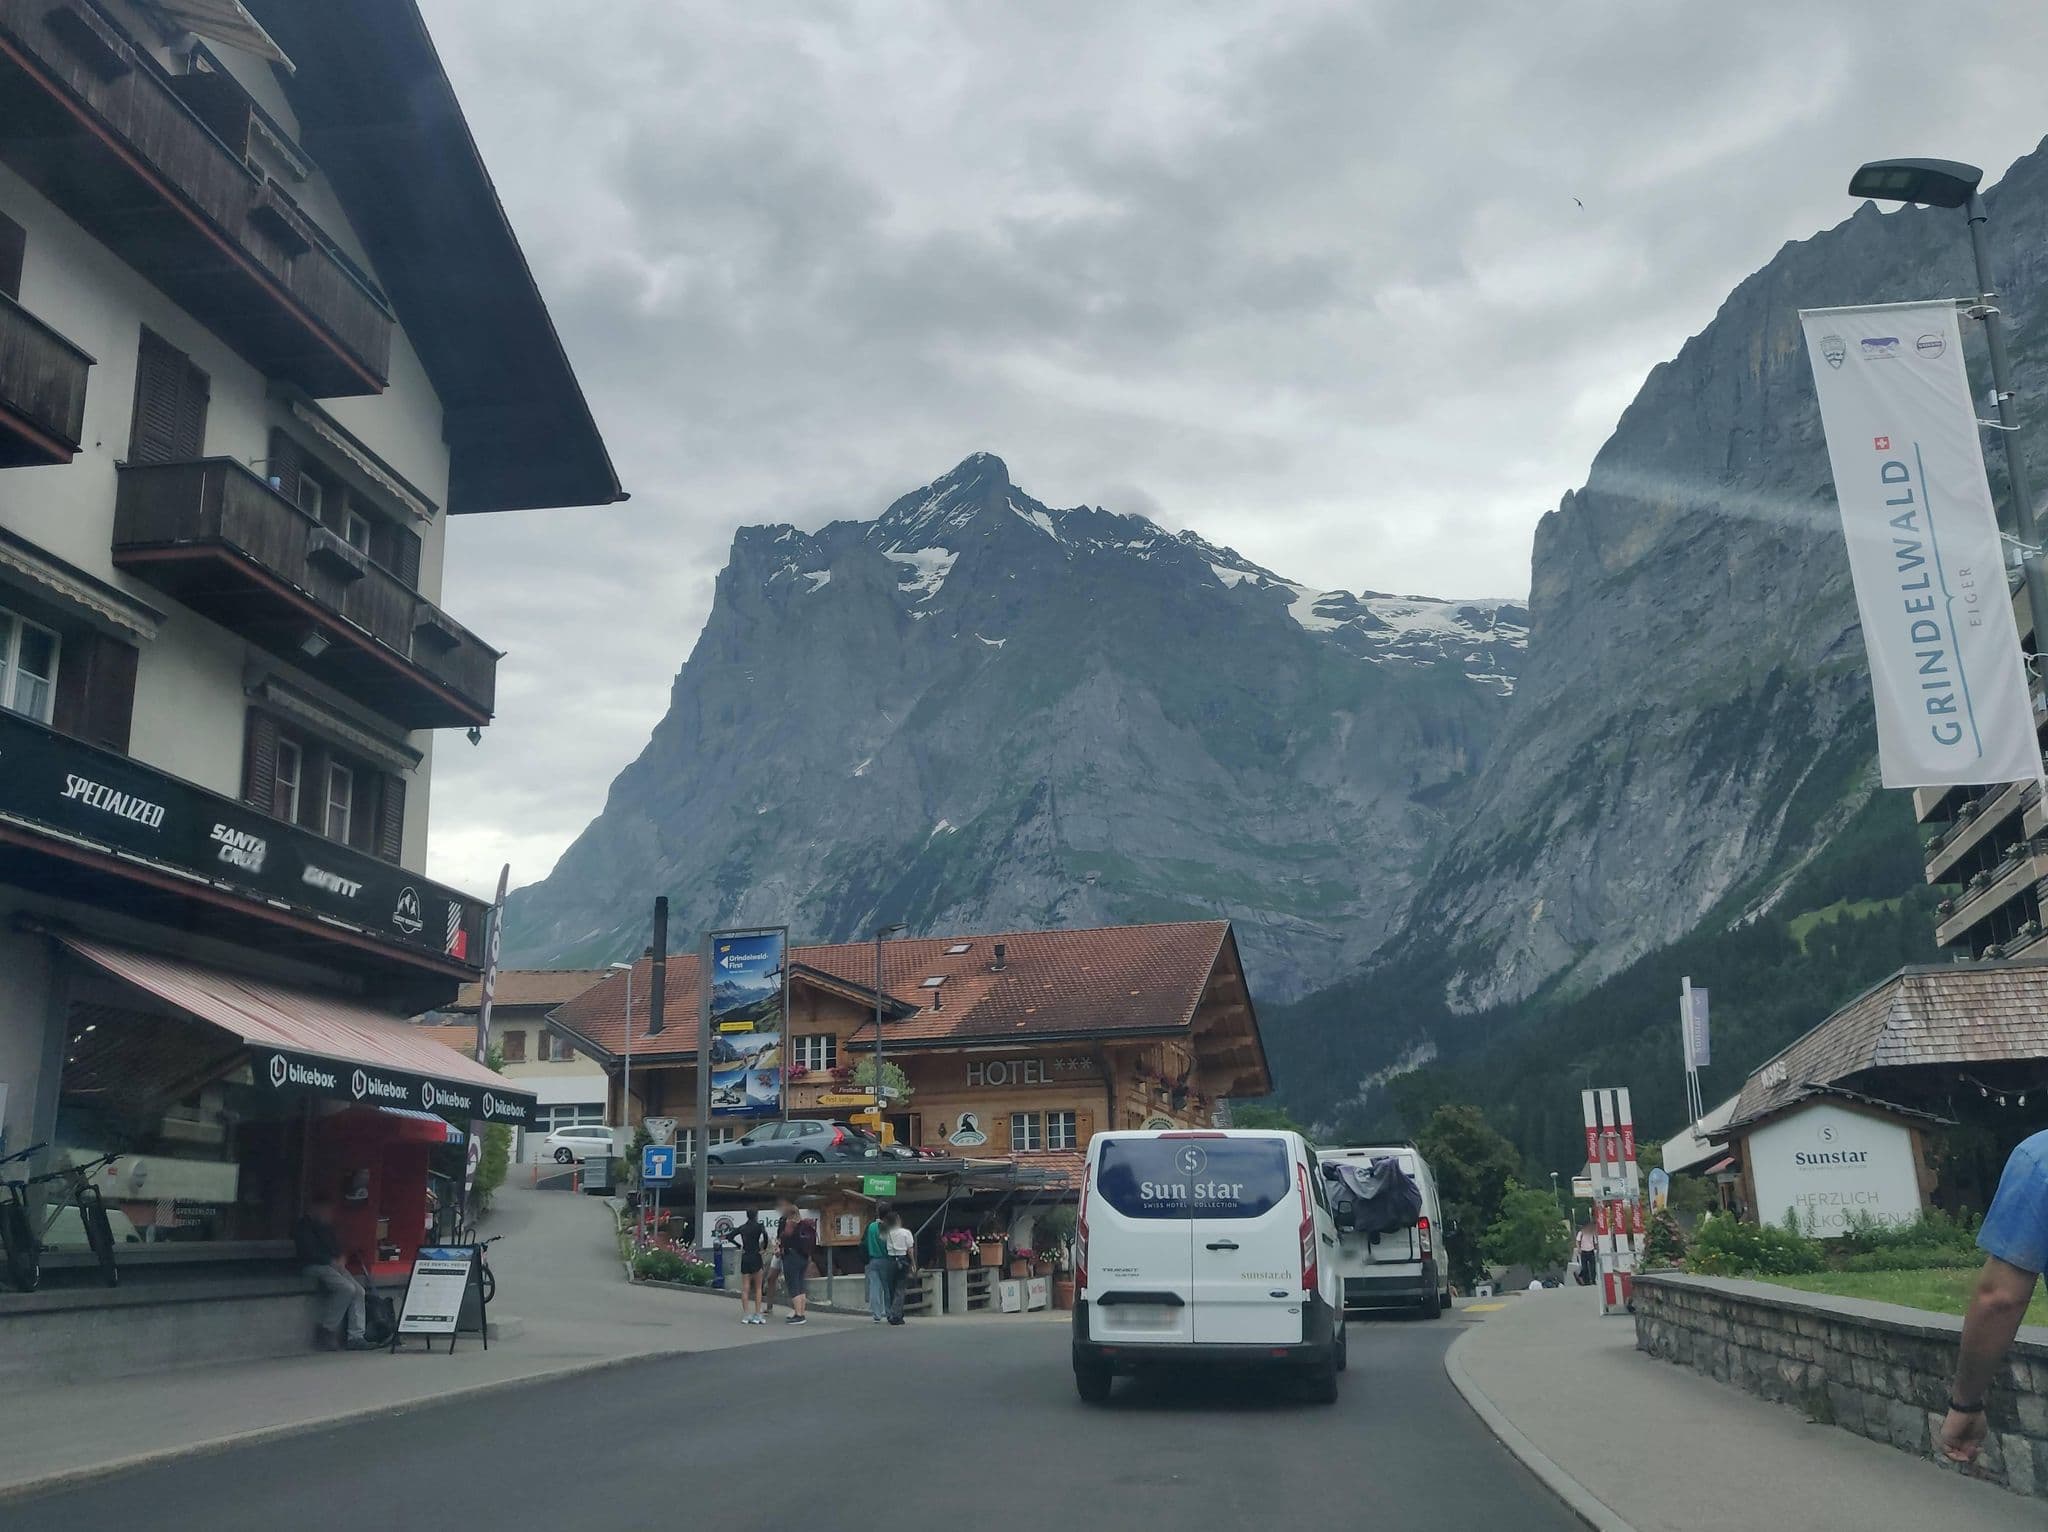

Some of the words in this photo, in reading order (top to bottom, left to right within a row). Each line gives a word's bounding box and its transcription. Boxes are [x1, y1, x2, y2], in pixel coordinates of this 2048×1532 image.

[1881, 461, 1963, 746] GRINDELWALD
[1959, 567, 1982, 627] EIGER
[60, 774, 165, 828] SPECIALIZED
[210, 823, 267, 852] SANTA
[289, 1063, 335, 1089] bikebox
[966, 1058, 1054, 1087] HOTEL
[367, 1077, 407, 1099] bikebox
[435, 1088, 470, 1110] bikebox
[494, 1101, 525, 1117] bikebox
[1185, 1150, 1197, 1170] S
[1795, 1150, 1868, 1166] Sunstar
[1140, 1181, 1187, 1200] Sun
[1194, 1180, 1244, 1200] star
[1795, 1191, 1880, 1207] HERZLICH
[1241, 1269, 1292, 1280] sunstar.ch
